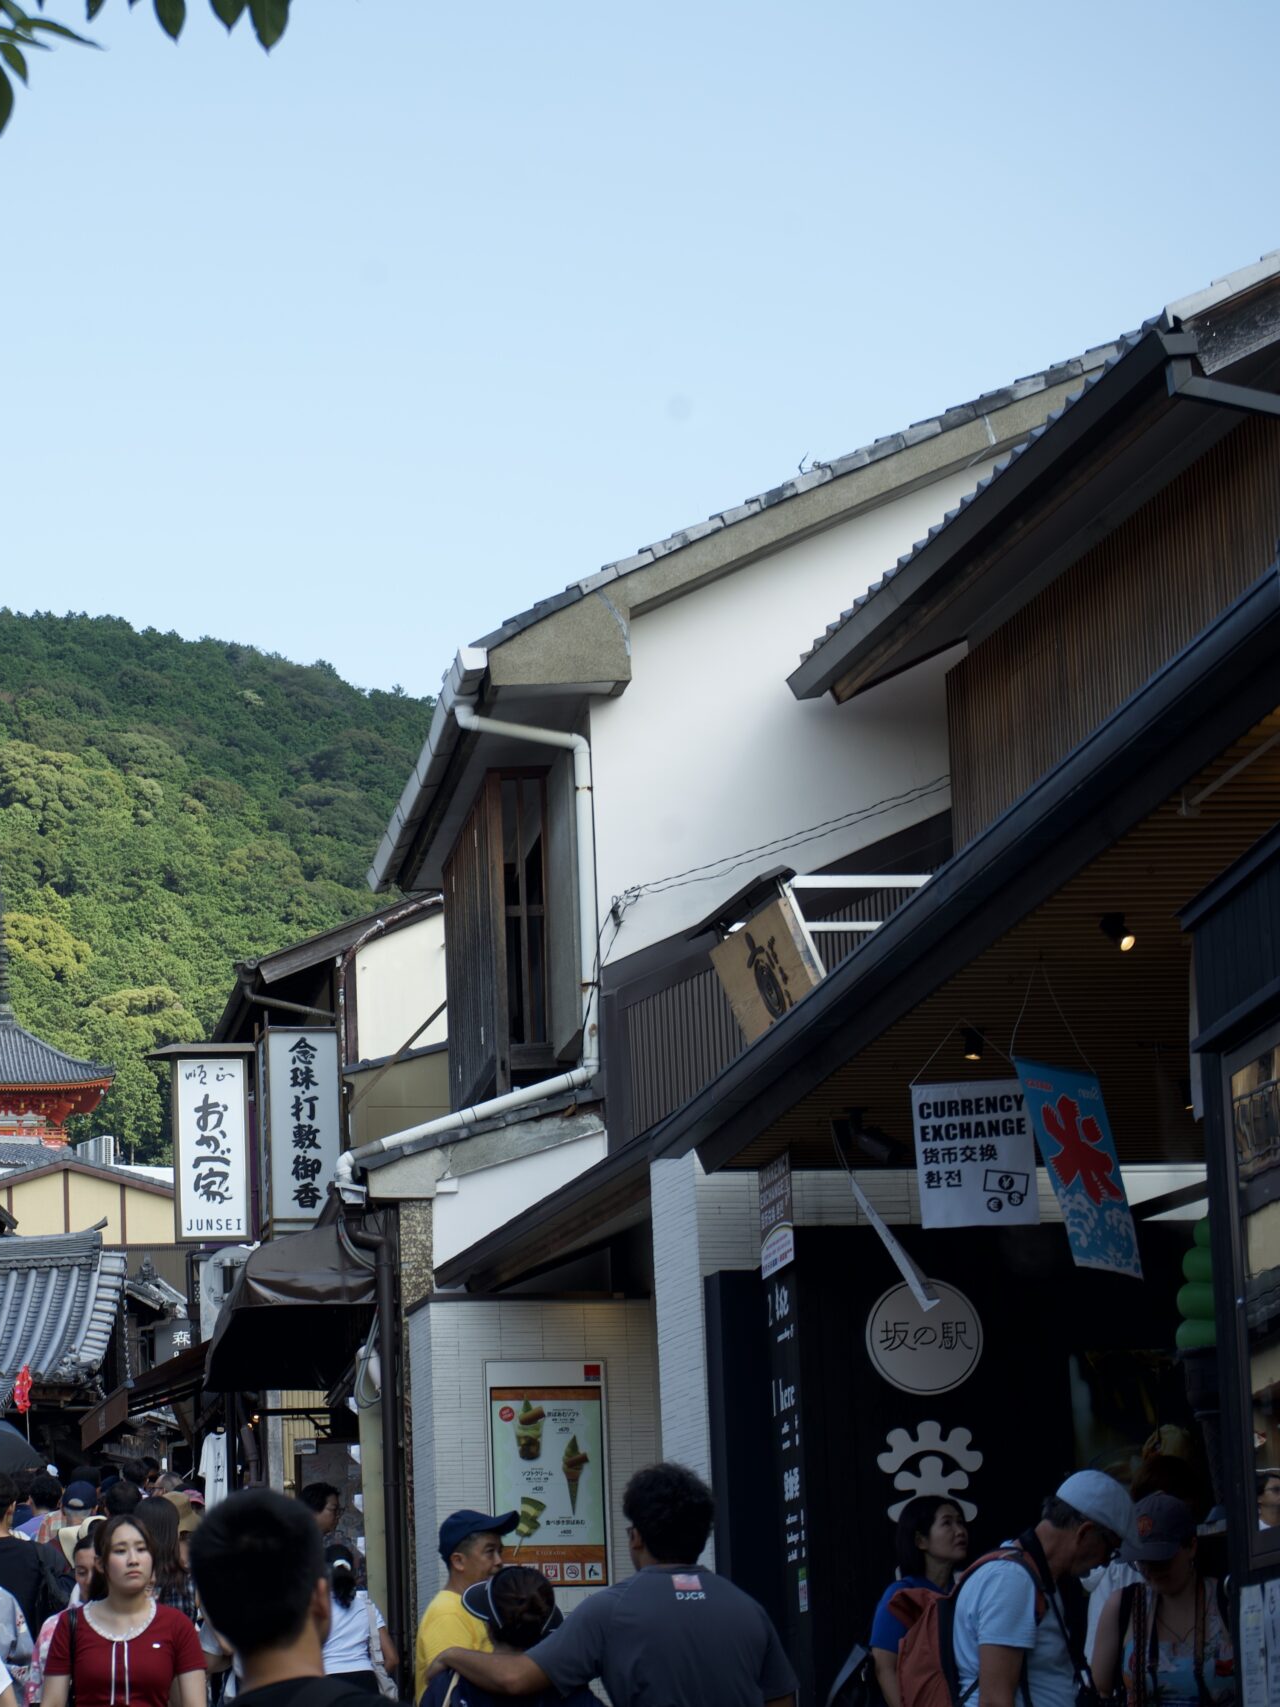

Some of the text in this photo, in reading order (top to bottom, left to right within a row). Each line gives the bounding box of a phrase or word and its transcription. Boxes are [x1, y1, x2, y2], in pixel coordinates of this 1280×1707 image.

[919, 1094, 1024, 1120] CURRENCY
[920, 1118, 1026, 1142] EXCHANGE
[922, 1144, 998, 1165] 货币交换
[925, 1169, 962, 1189] 환전
[186, 1218, 242, 1231] JUNSEI
[880, 1320, 973, 1351] 坂の駅
